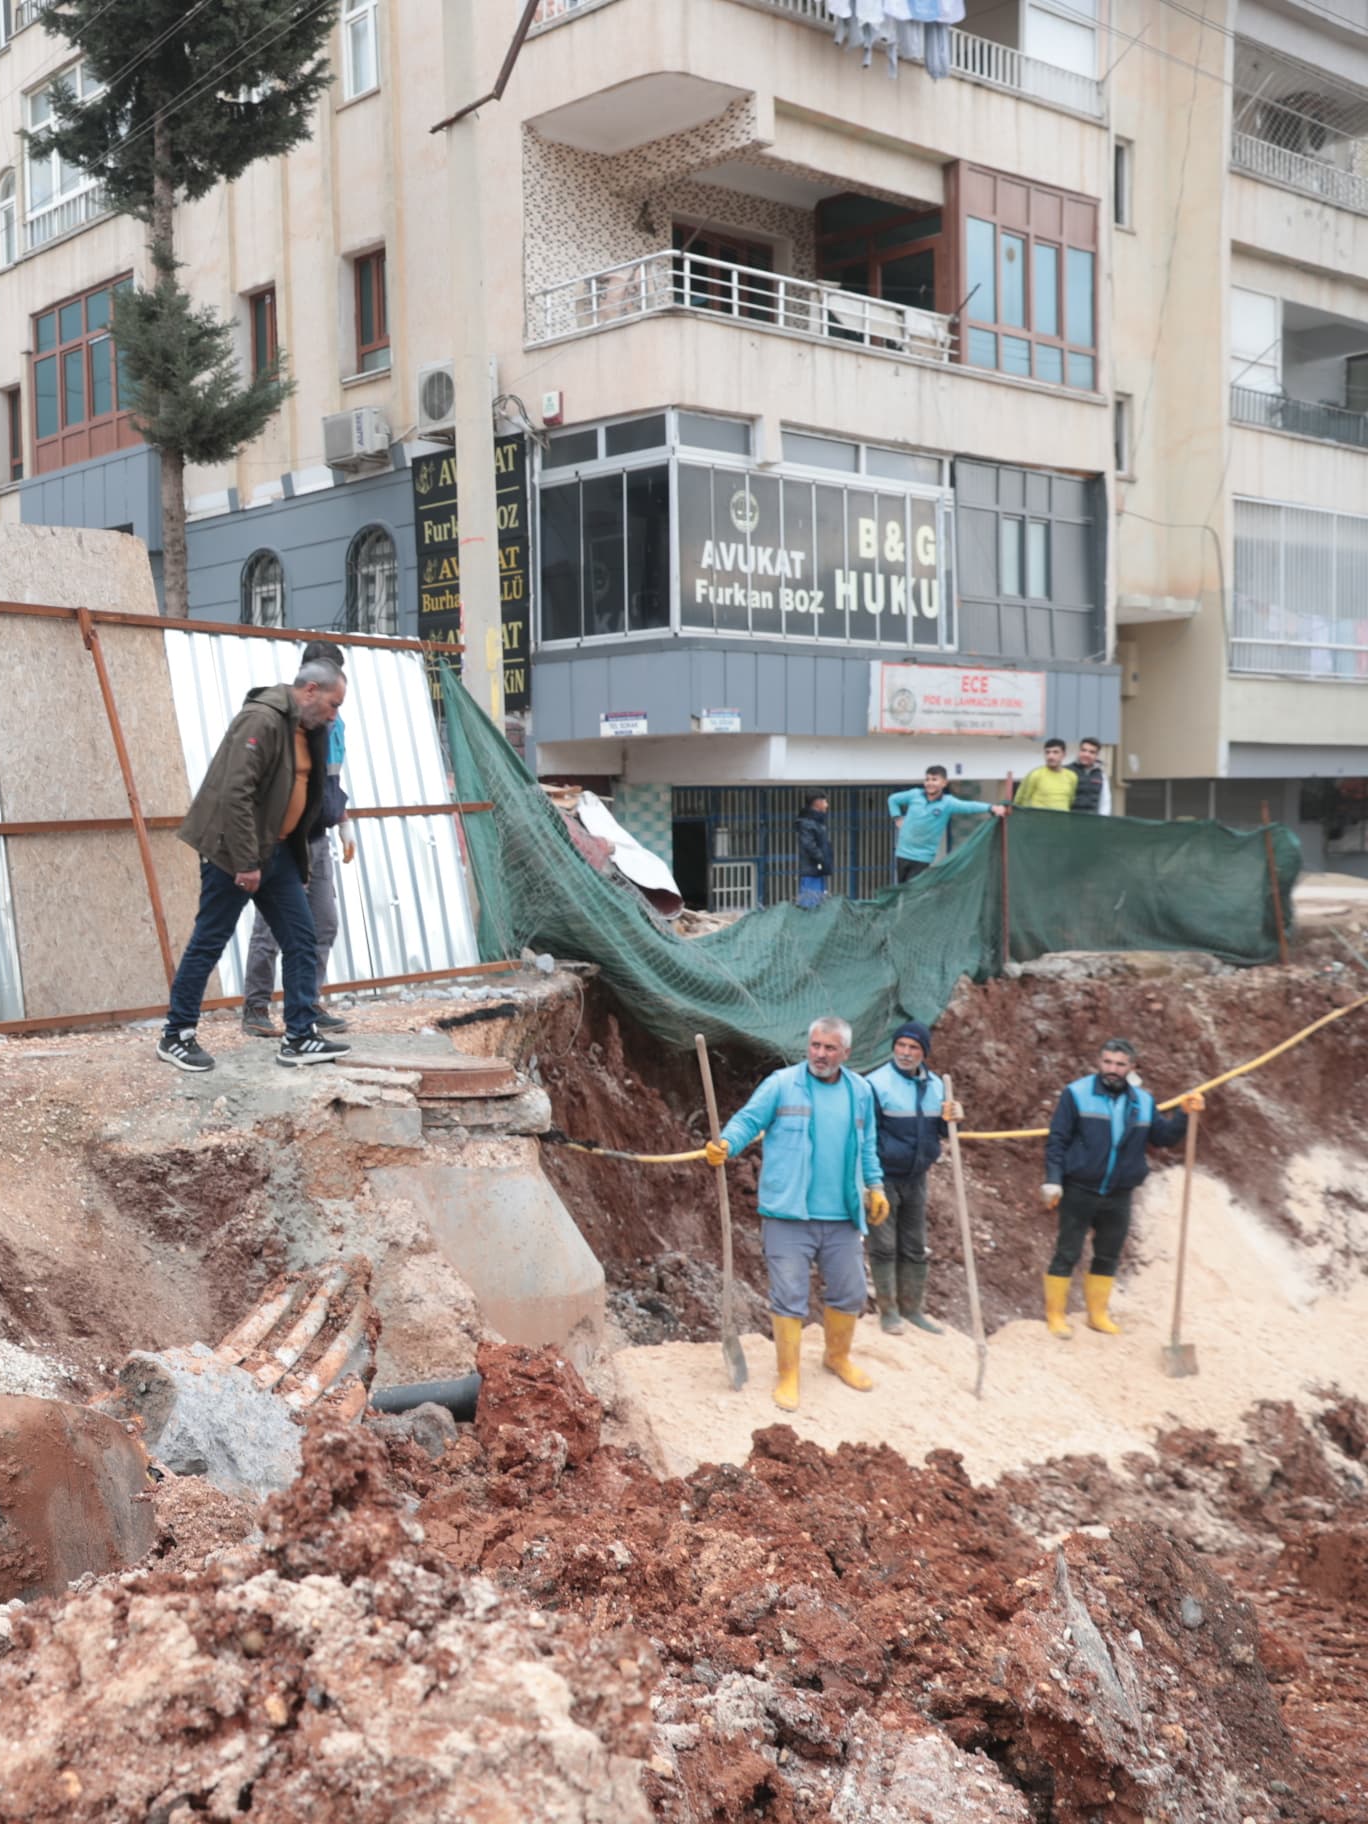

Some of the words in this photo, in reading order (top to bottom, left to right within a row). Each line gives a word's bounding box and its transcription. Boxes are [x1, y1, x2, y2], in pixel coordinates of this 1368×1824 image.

[497, 503, 520, 530] OZ
[701, 539, 805, 579] AVUKAT
[422, 590, 461, 613] Burha
[695, 578, 773, 609] Furkan
[779, 588, 824, 613] BOZ
[961, 675, 989, 694] ECE
